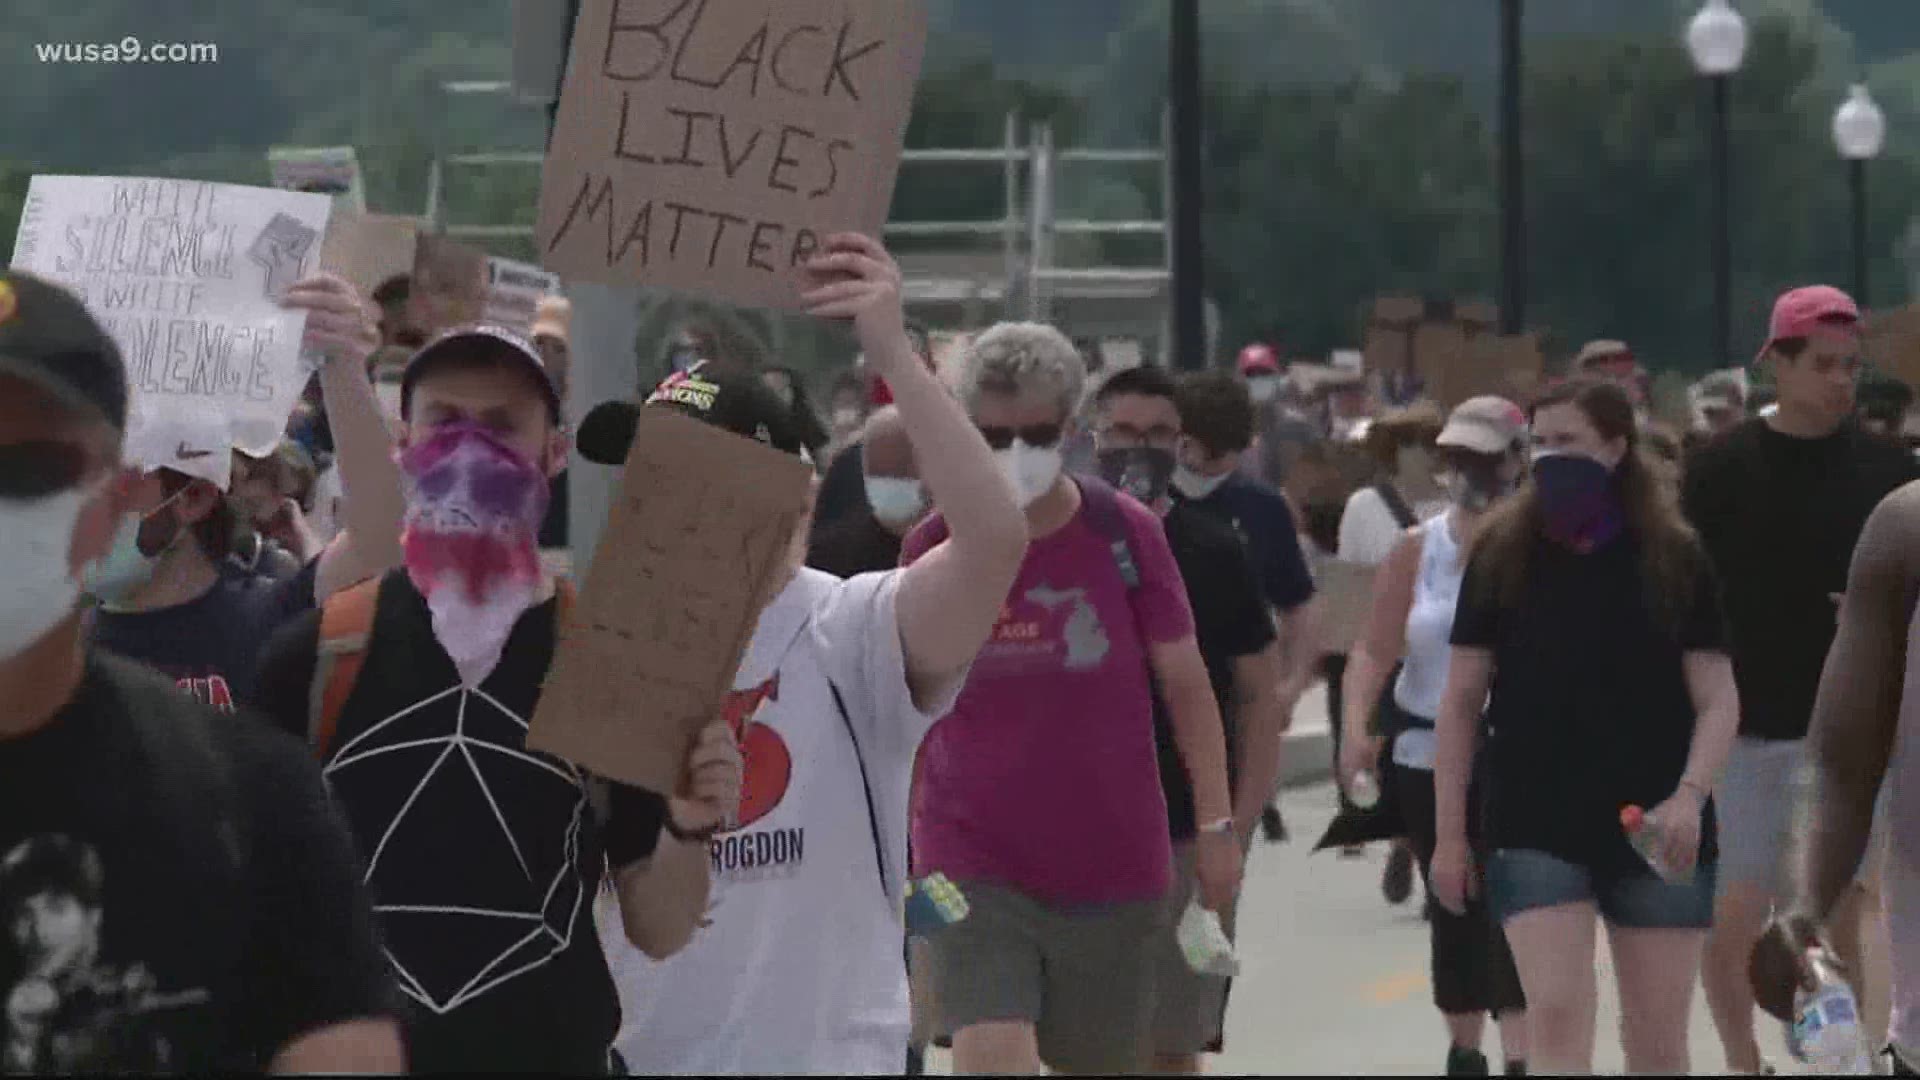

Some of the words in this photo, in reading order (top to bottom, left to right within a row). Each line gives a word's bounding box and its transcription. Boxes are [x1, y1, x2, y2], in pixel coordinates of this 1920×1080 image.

[602, 0, 885, 100] BLACK
[614, 91, 854, 198] LIVES
[548, 173, 818, 273] MATTER
[709, 827, 805, 873] ROGDON
